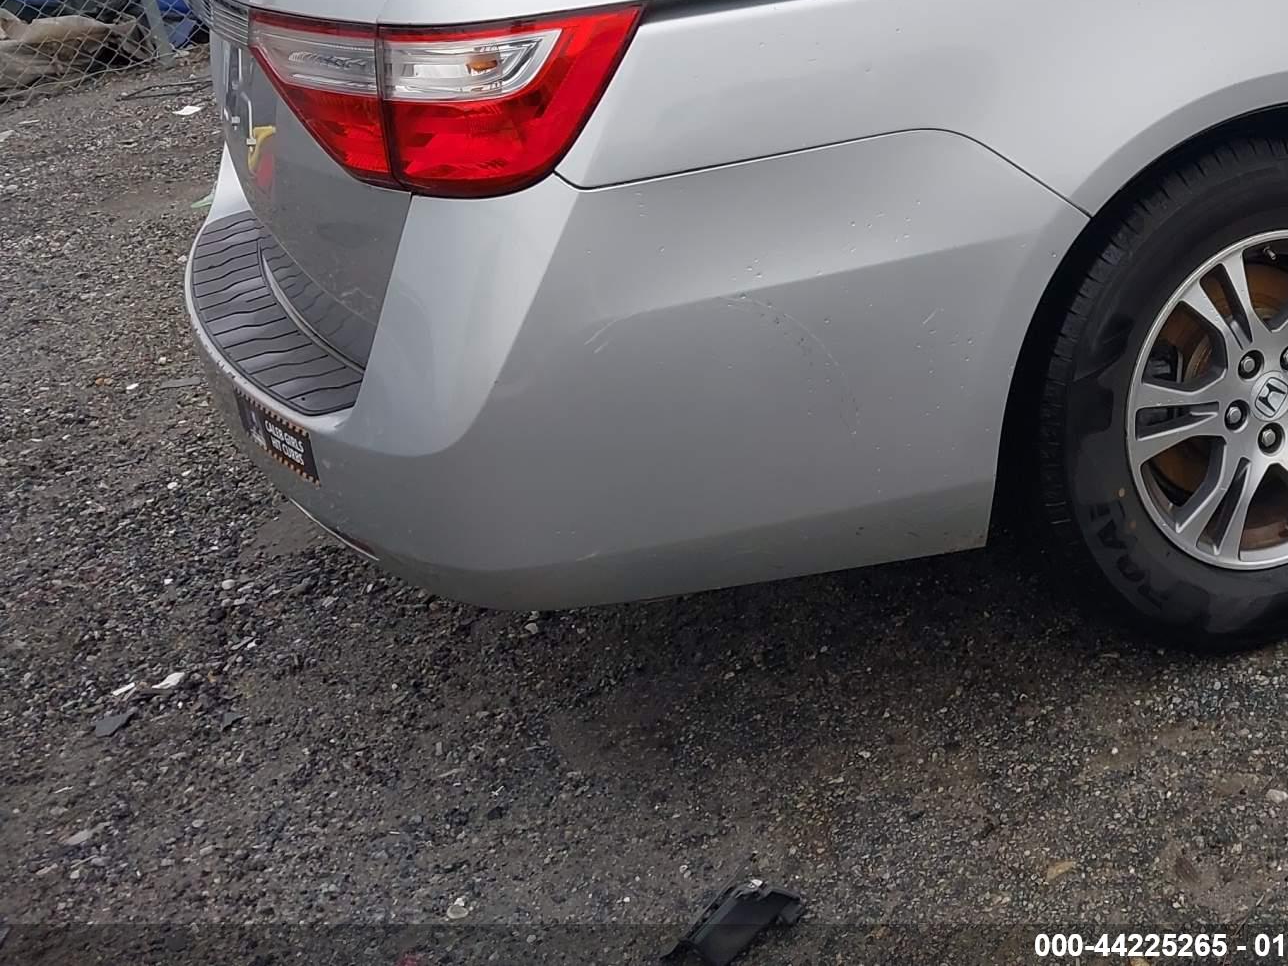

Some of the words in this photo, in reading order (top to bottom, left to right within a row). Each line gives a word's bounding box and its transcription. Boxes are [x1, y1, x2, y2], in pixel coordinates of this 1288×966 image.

[270, 435, 282, 451] HIT
[281, 443, 304, 466] CURBS
[283, 432, 304, 453] GIRLS
